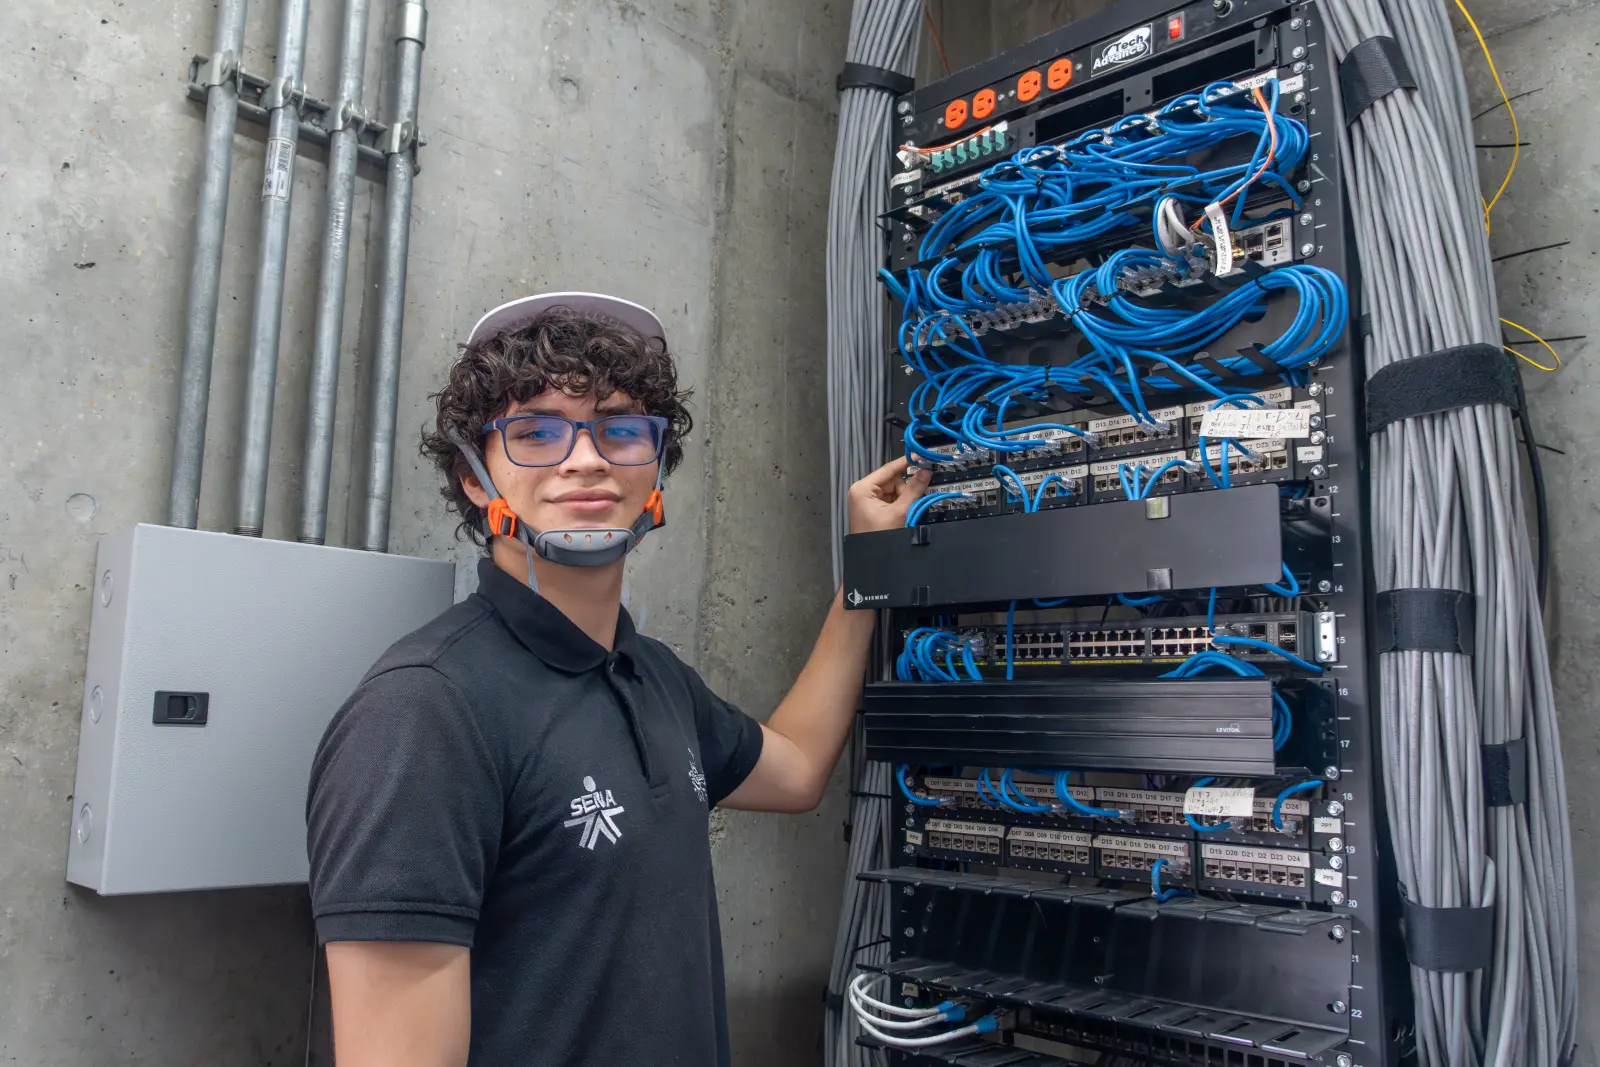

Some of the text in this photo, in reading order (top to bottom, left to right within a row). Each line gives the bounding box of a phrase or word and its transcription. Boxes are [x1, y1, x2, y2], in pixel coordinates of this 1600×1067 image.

[1305, 19, 1312, 27] 2
[1115, 35, 1144, 51] Tech
[1093, 42, 1145, 70] Advance
[1308, 63, 1315, 71] 3
[1312, 153, 1319, 161] 5
[1315, 198, 1321, 206] 6
[1318, 245, 1324, 253] 7
[1325, 387, 1334, 395] 10
[1326, 435, 1335, 443] 11
[1328, 485, 1339, 493] 12
[1332, 535, 1341, 543] 13
[1334, 585, 1344, 593] 14
[1336, 636, 1346, 644] 15
[1338, 688, 1348, 696] 16
[1340, 740, 1350, 748] 17
[570, 789, 618, 817] SENA
[1209, 847, 1222, 855] D19
[1241, 850, 1254, 858] D21
[1345, 845, 1356, 854] 19
[1347, 900, 1358, 908] 20
[1351, 1009, 1363, 1018] 22
